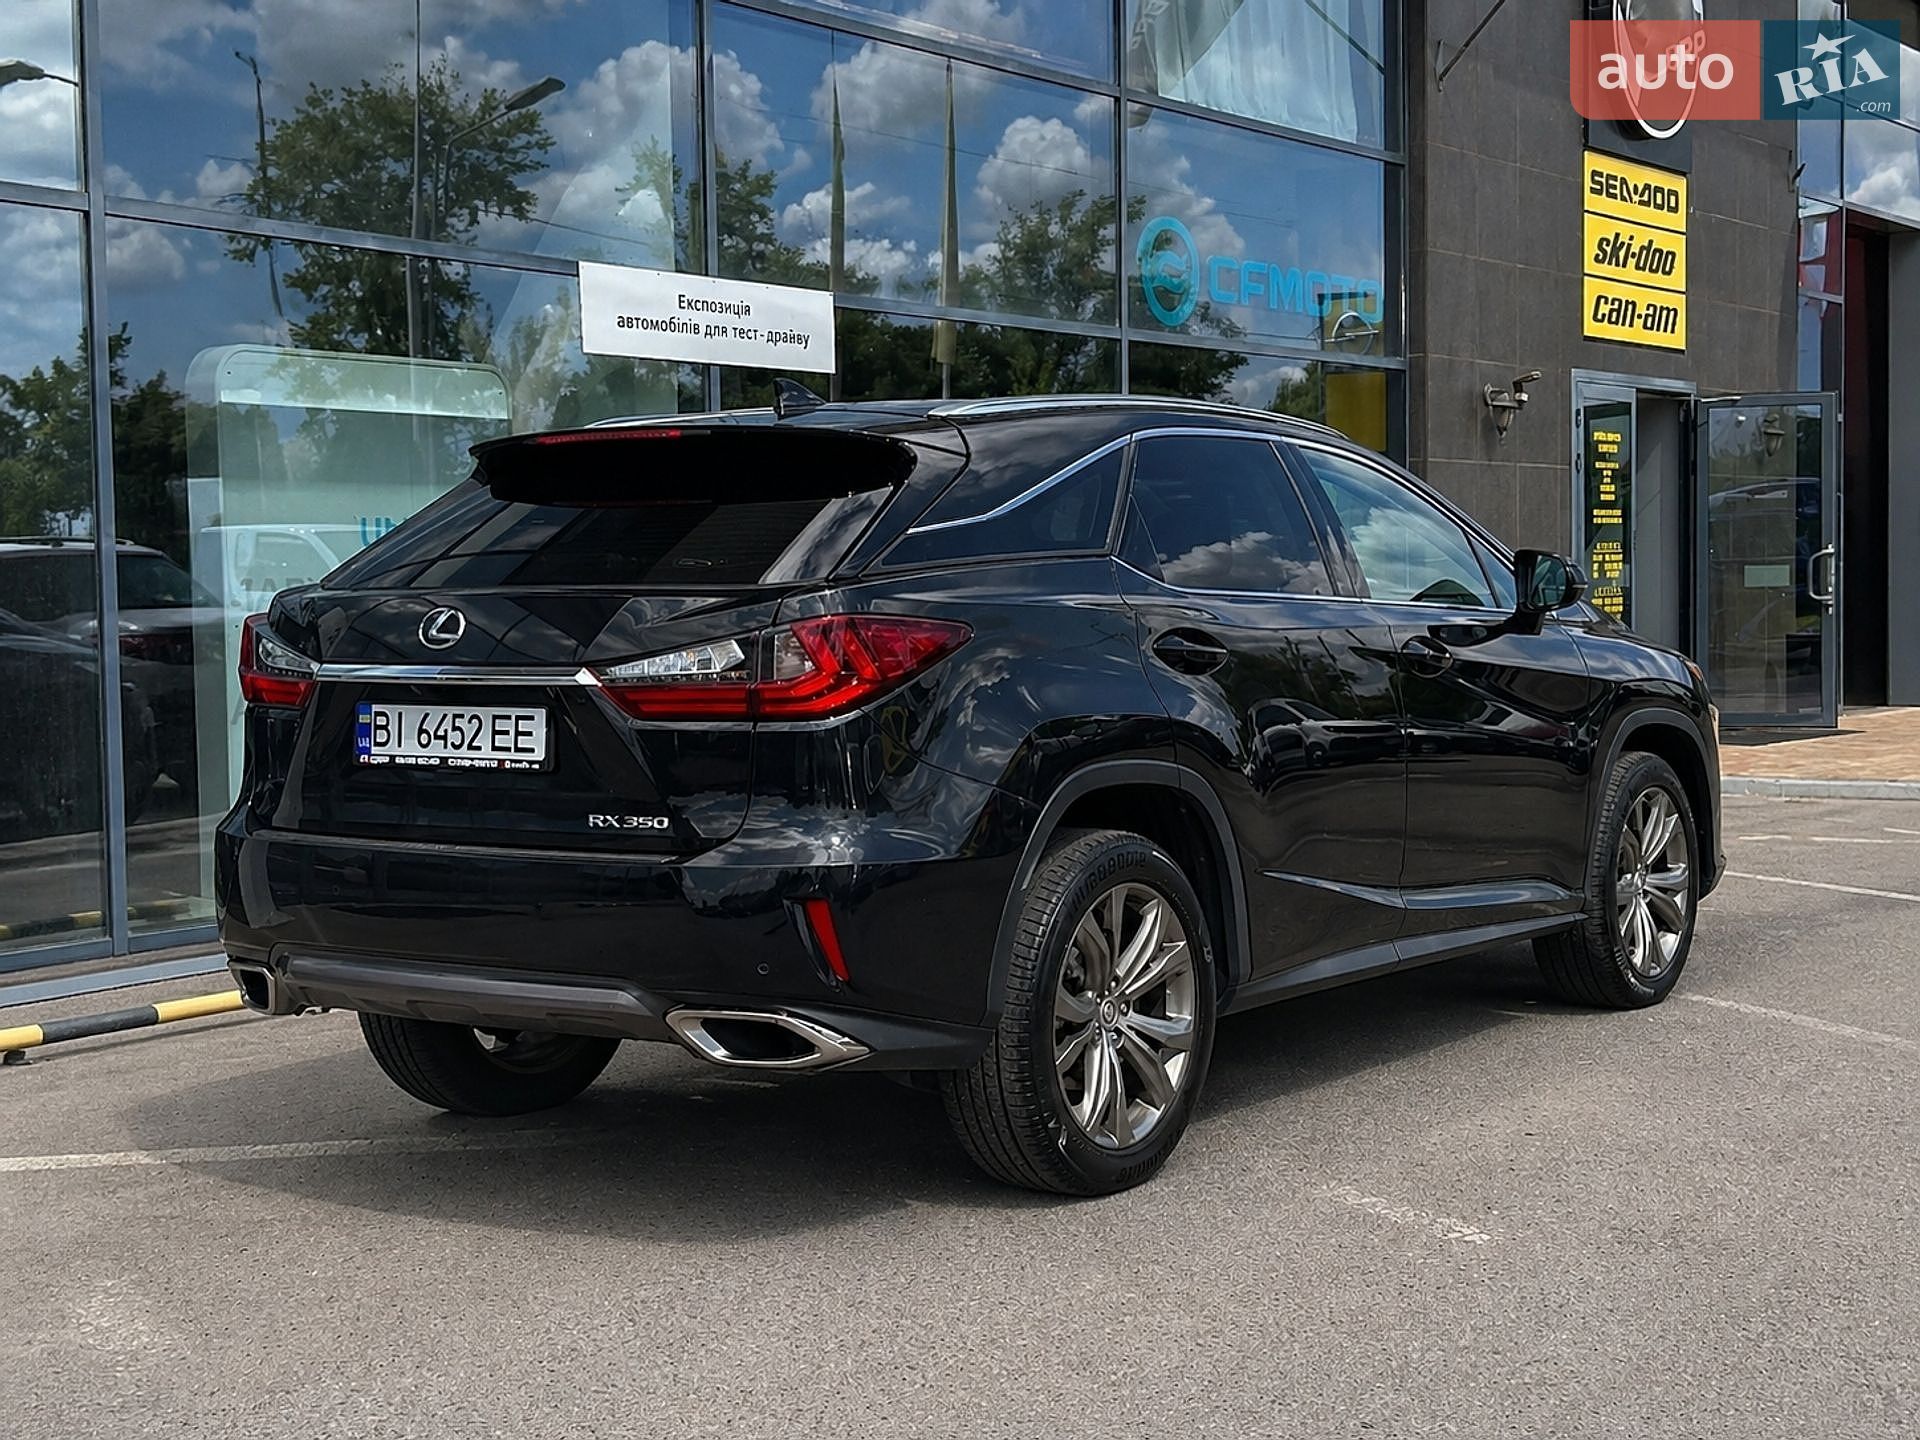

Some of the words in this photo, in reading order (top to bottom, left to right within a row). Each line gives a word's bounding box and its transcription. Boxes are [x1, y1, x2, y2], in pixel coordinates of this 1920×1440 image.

[1207, 255, 1384, 324] CFMOTO
[677, 293, 751, 319] Експозиція
[616, 314, 700, 336] автомобілів
[704, 323, 728, 340] для
[373, 710, 403, 749] BI
[416, 711, 484, 752] 6452
[490, 713, 536, 754] EE
[587, 813, 620, 828] RX
[622, 815, 670, 829] 350
